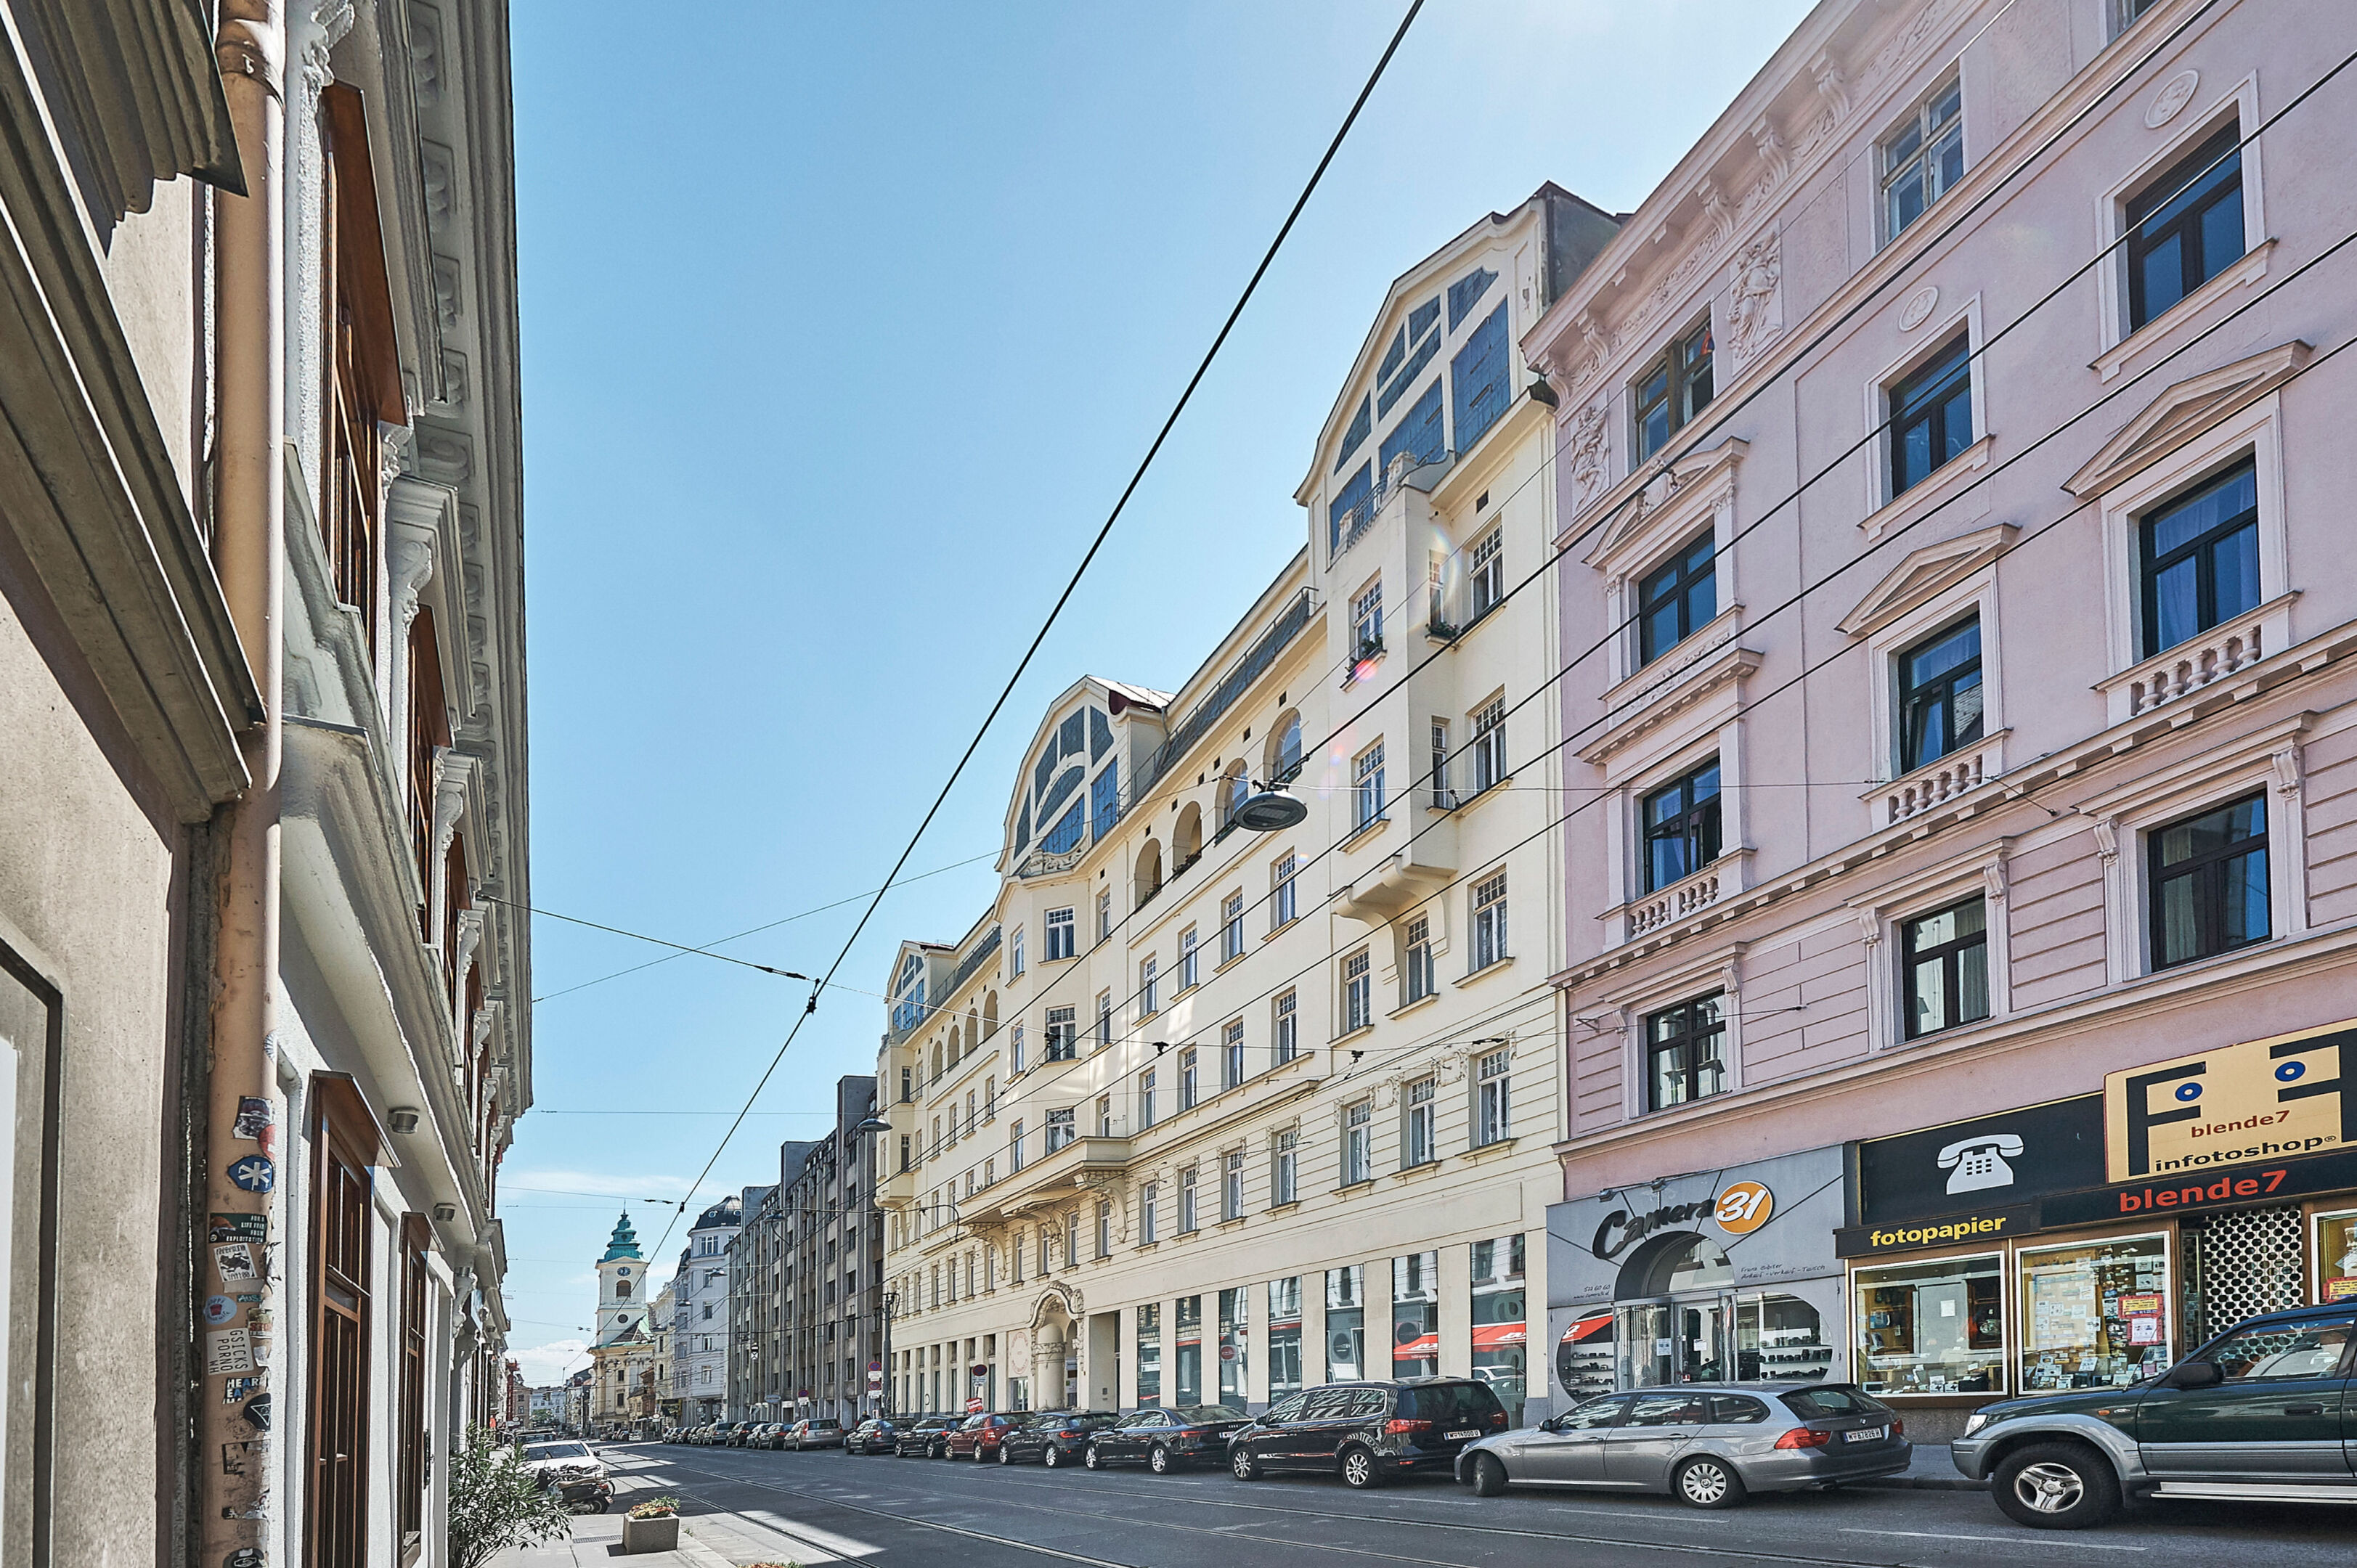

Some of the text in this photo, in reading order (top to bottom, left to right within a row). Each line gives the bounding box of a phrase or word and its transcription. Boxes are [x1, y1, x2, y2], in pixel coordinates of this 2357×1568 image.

[2191, 1110, 2290, 1138] blende7
[2120, 1169, 2287, 1212] blende7
[1592, 1189, 1768, 1259] Camera 31
[1870, 1217, 2007, 1247] fotopapier
[217, 1338, 233, 1371] PORNO
[229, 1330, 248, 1369] GSICKS
